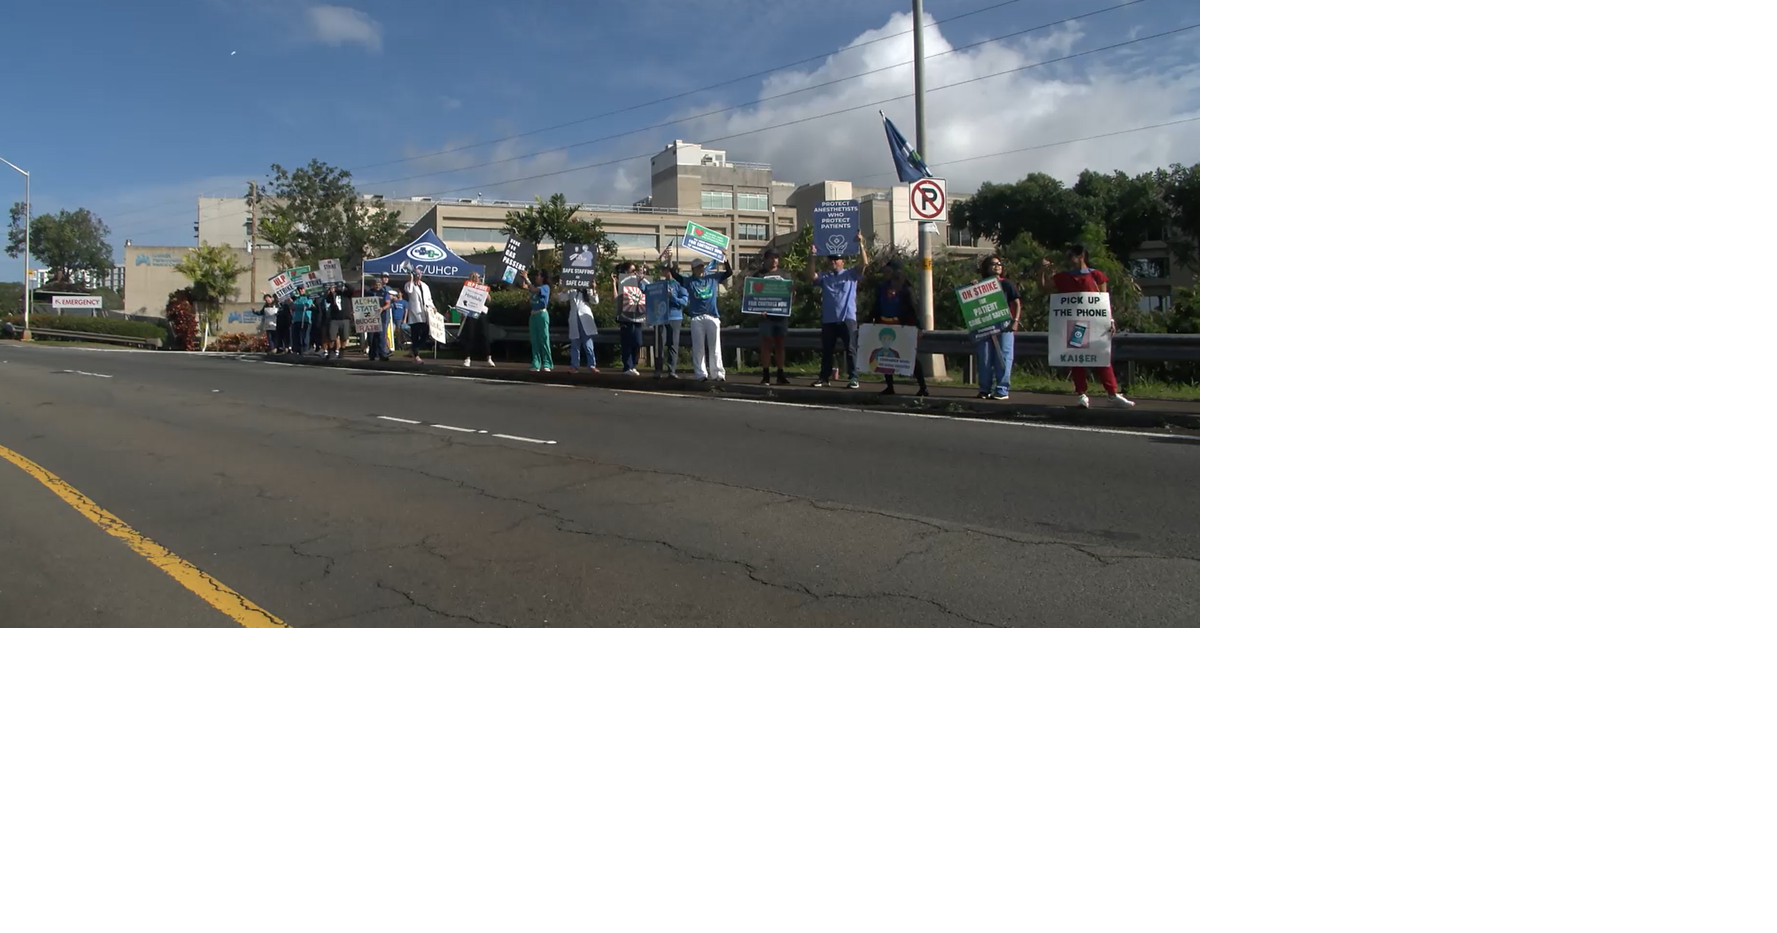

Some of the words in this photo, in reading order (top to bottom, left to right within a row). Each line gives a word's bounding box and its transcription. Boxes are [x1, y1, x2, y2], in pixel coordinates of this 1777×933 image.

[505, 249, 516, 260] GAS
[273, 274, 286, 287] ULP
[305, 279, 322, 288] STRIKE
[276, 284, 295, 299] STRIKE
[961, 289, 973, 300] ON
[973, 281, 998, 297] STRIKE
[1060, 296, 1084, 304] PICK
[1087, 296, 1100, 304] UP
[355, 304, 378, 313] STATE
[972, 301, 998, 317] PATIENT
[991, 308, 1010, 319] SAFETY
[1053, 309, 1073, 317] THE
[1076, 308, 1107, 317] PHONE
[356, 317, 380, 325] BUDGET
